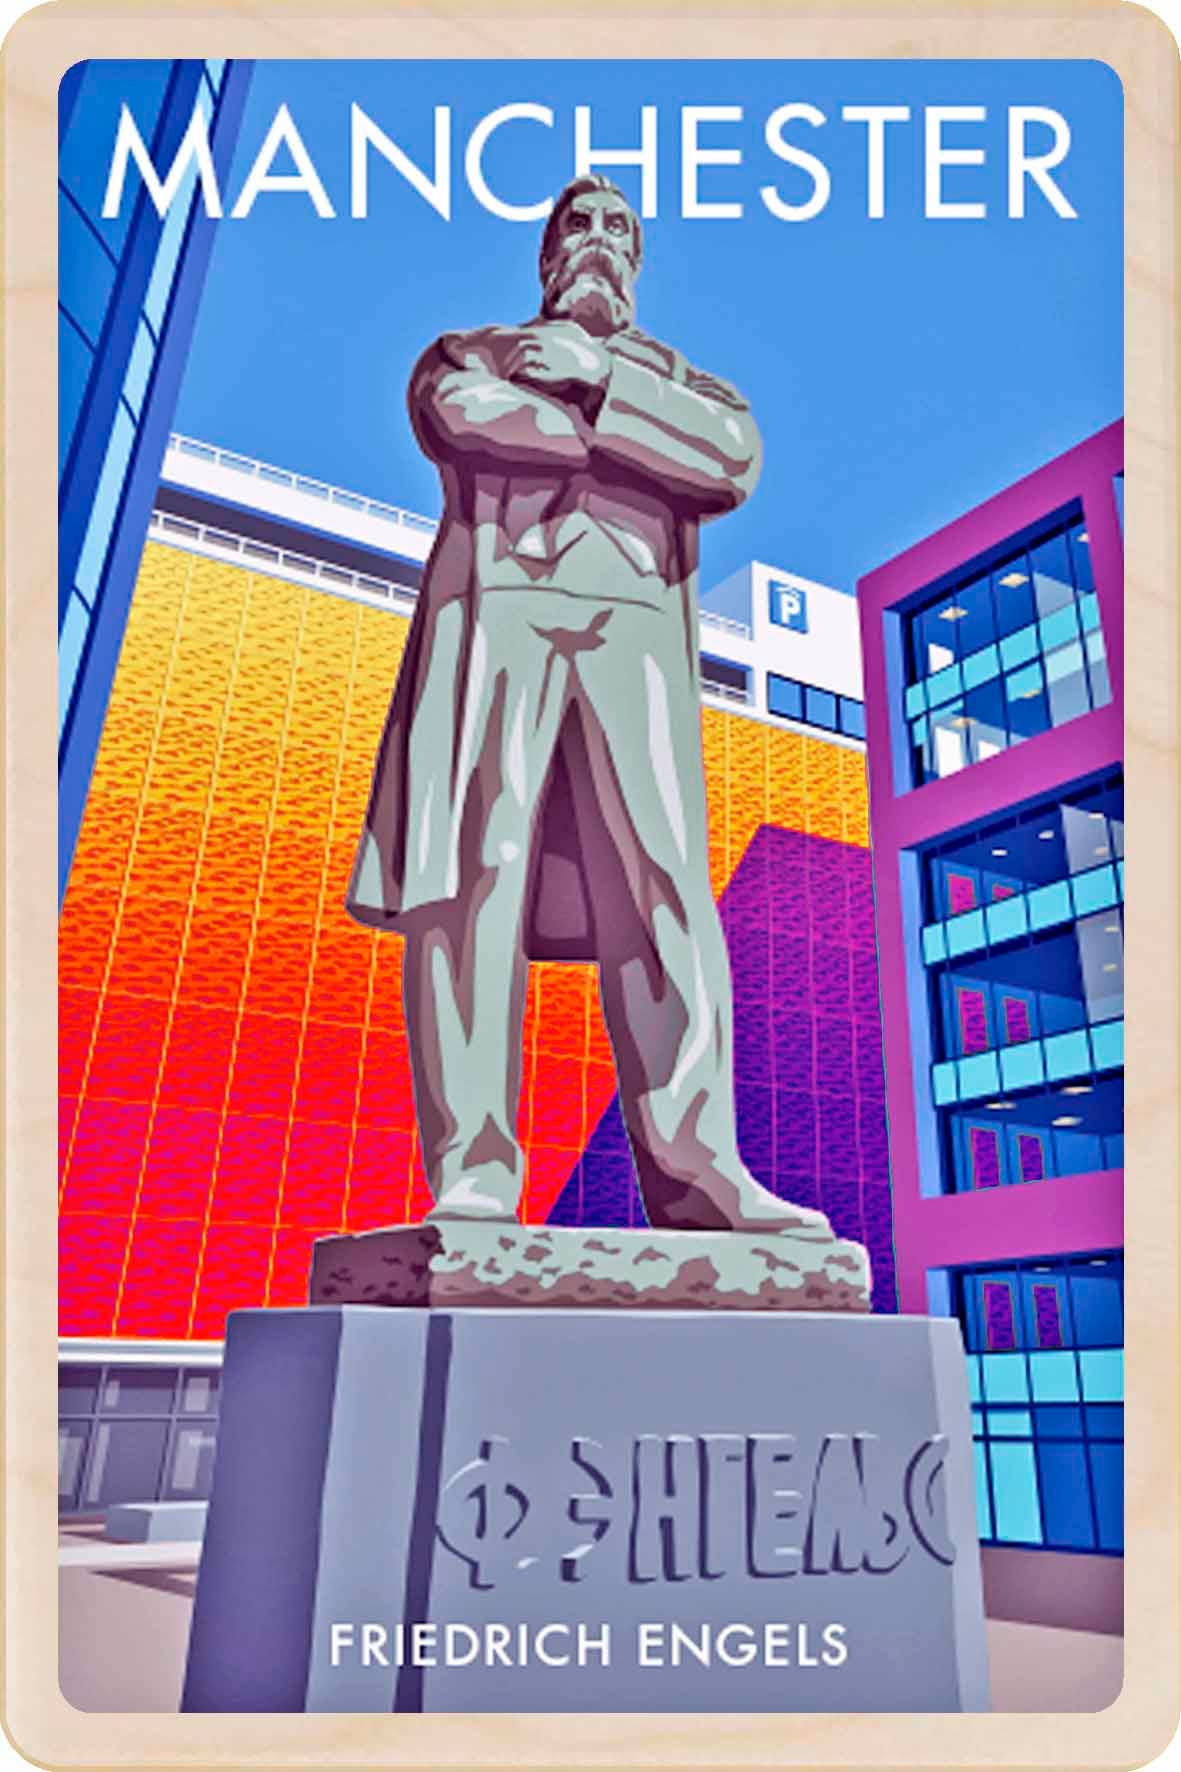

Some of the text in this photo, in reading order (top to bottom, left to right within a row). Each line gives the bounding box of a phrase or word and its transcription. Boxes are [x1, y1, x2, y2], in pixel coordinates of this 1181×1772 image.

[102, 102, 1078, 222] MANCHESTER
[780, 592, 801, 624] P
[330, 1623, 848, 1667] FRIEDRICH ENGELS
